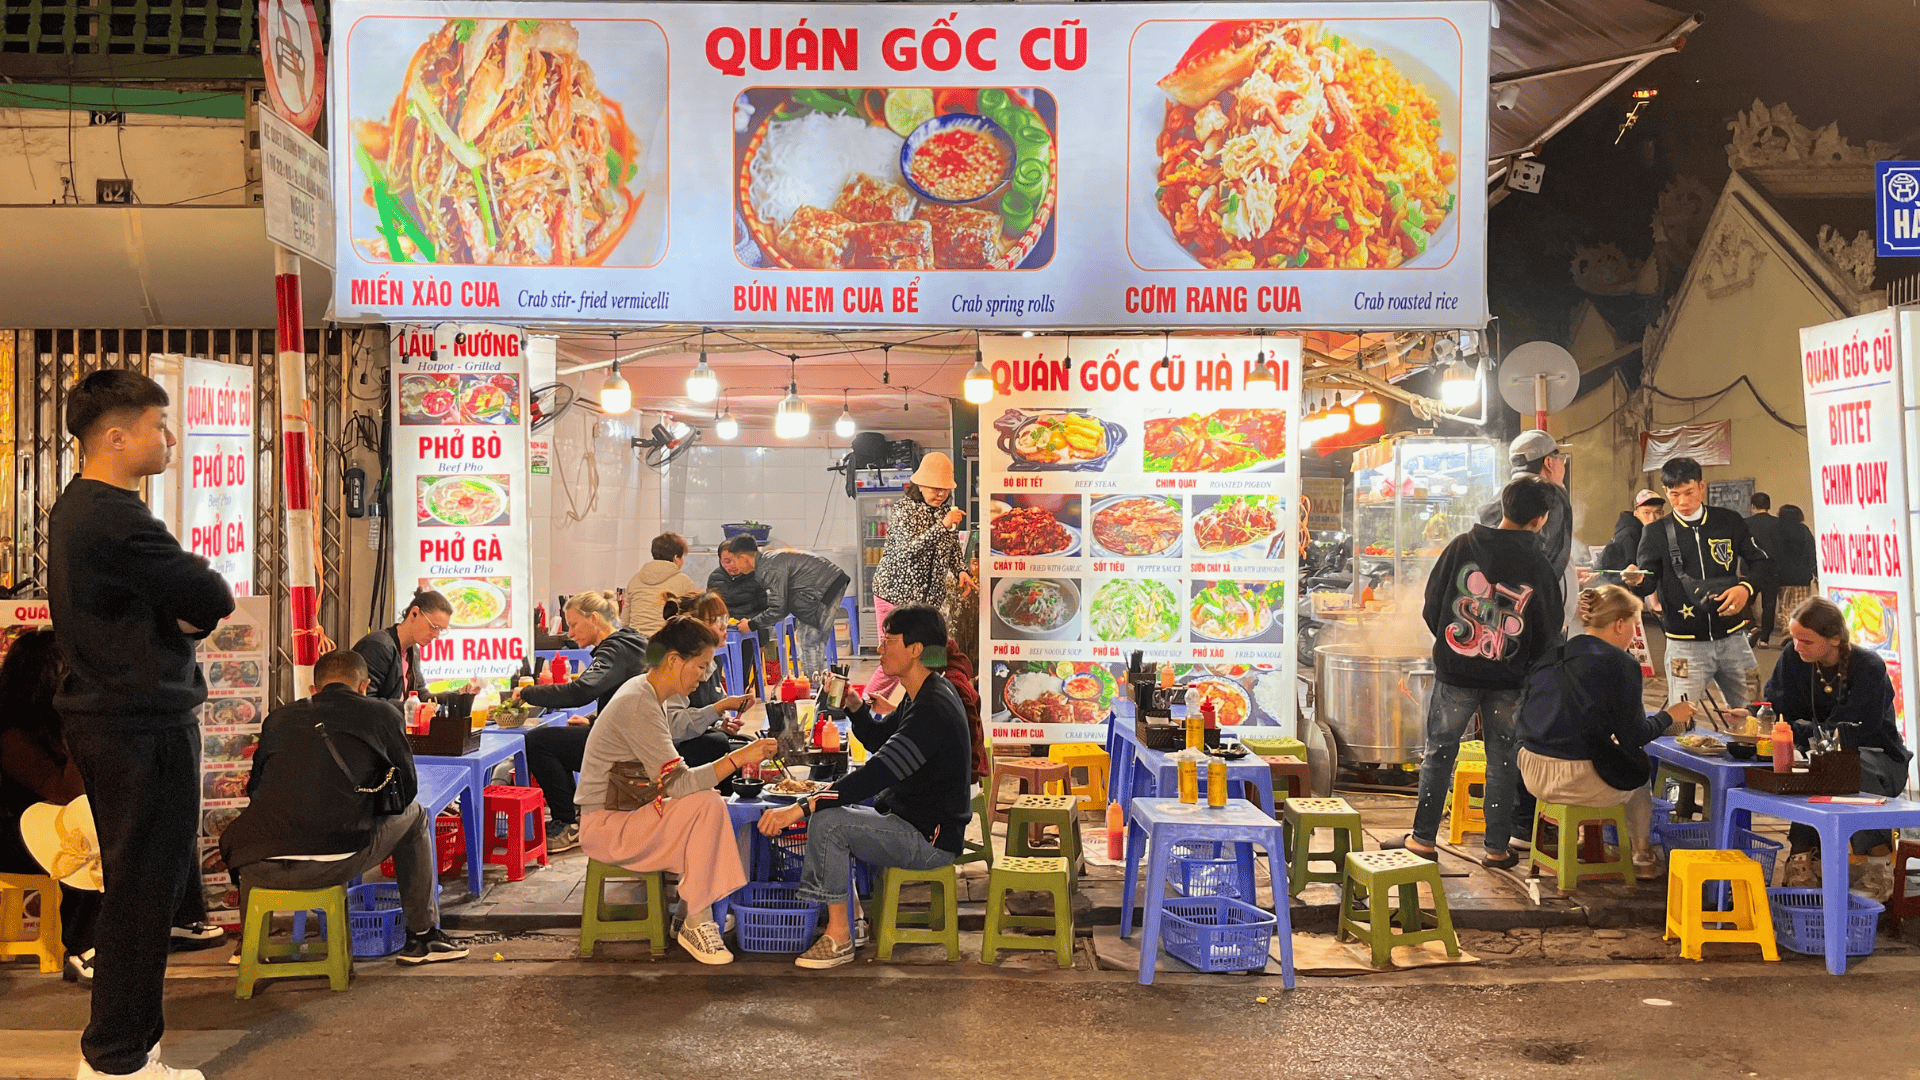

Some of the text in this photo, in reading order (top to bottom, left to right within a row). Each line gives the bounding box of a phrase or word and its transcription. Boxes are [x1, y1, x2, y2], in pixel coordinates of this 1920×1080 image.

[705, 12, 1088, 76] QUÁN GỐC CŨ
[294, 221, 316, 251] Except
[351, 271, 500, 307] MIẾN XÀO CUA
[518, 289, 547, 308] Crab
[578, 290, 607, 312] fried
[612, 291, 669, 310] vermicelli
[734, 276, 920, 313] BÚN NEM CUA BỂ
[1125, 284, 1302, 313] CƠM RANG CUA
[1354, 291, 1458, 310] Crab roasted rice
[951, 294, 1055, 317] Crab spring rolls
[399, 324, 434, 357] LẨU
[454, 329, 518, 357] NƯỚNG
[417, 362, 454, 373] Hotpot
[464, 361, 501, 371] Grilled
[1806, 328, 1892, 388] QUÁN GỐC CŨ
[990, 353, 1069, 395] QUÁN
[1080, 349, 1139, 392] GỐC
[1150, 354, 1185, 392] CŨ
[1196, 352, 1233, 391] HÀ
[187, 376, 251, 429] QUÁN GỐC CŨ
[1828, 400, 1871, 446] BITTET
[419, 428, 502, 459] PHỞ BÒ
[192, 444, 245, 488] PHỞ BÒ
[438, 462, 483, 473] Beef Pho
[1004, 475, 1014, 487] BÒ
[1030, 474, 1043, 487] TẾT
[1075, 480, 1117, 488] BEEF STEAK
[1155, 478, 1197, 489] CHIM QUAY
[1821, 461, 1888, 510] CHIM QUAY
[191, 513, 245, 557] PHỞ GÀ
[420, 531, 503, 562] PHỞ GÀ
[1821, 518, 1902, 577] SƯỜN CHIÊN SẢ
[430, 565, 494, 575] Chicken Pho
[1029, 564, 1046, 572] FRIED
[1047, 564, 1061, 572] WITH
[1162, 565, 1182, 573] SAUCE
[15, 604, 51, 621] QUÁ
[463, 637, 523, 660] RANG
[993, 642, 1020, 655] PHỞ BÒ
[1044, 648, 1066, 656] NOODLE
[1067, 648, 1082, 656] SOUP
[1092, 644, 1108, 656] PHỞ
[1109, 645, 1119, 656] GÀ
[1192, 645, 1224, 657] PHỞ XÀO
[1235, 650, 1282, 658] FRIED NOODLE
[421, 665, 442, 676] ried
[444, 665, 462, 675] rice
[992, 726, 1044, 738] BÚN NEM CUA
[1084, 731, 1106, 739] SPRING
